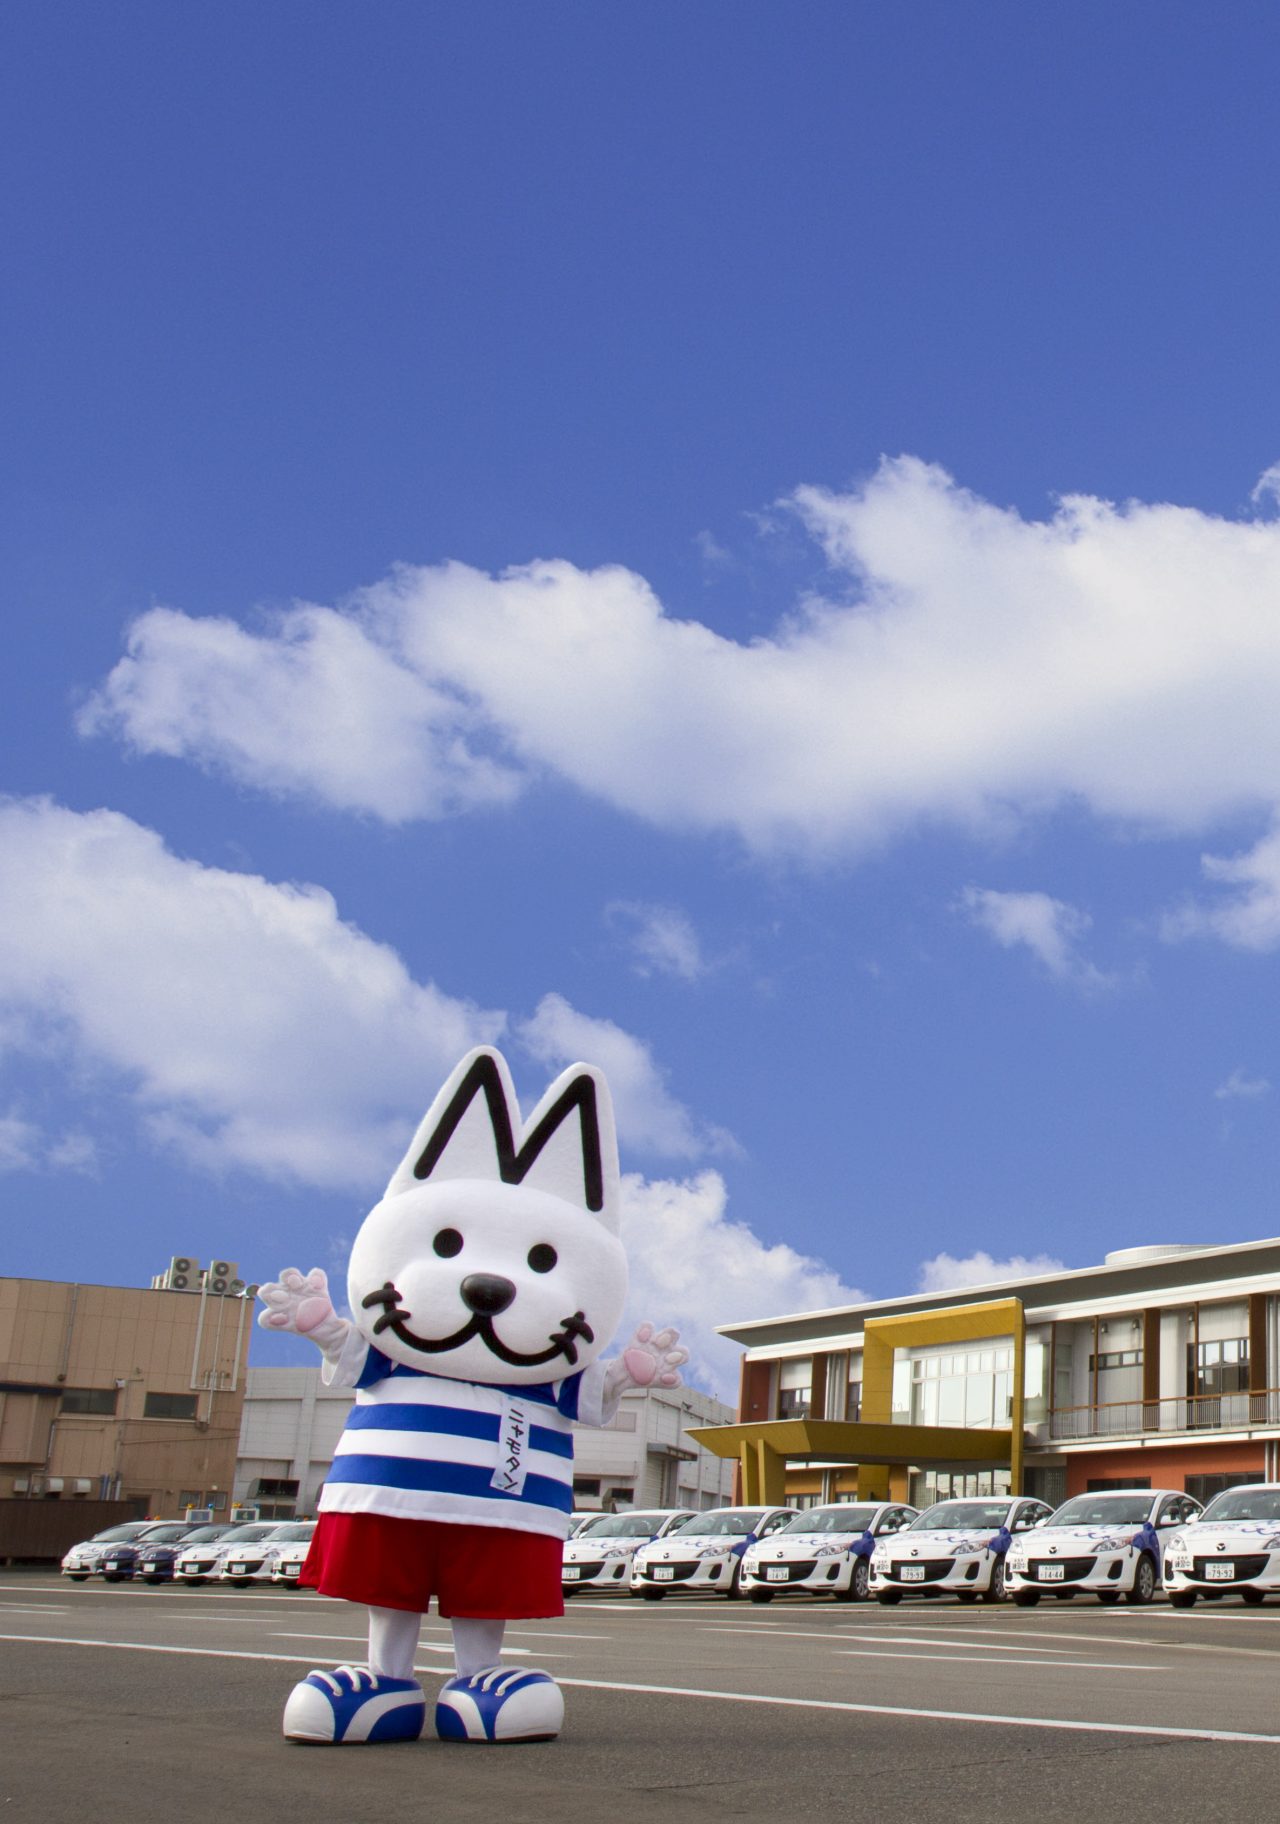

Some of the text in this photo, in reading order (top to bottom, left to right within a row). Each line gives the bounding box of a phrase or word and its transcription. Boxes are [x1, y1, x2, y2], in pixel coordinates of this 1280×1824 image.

[504, 1408, 524, 1490] ニャモタン
